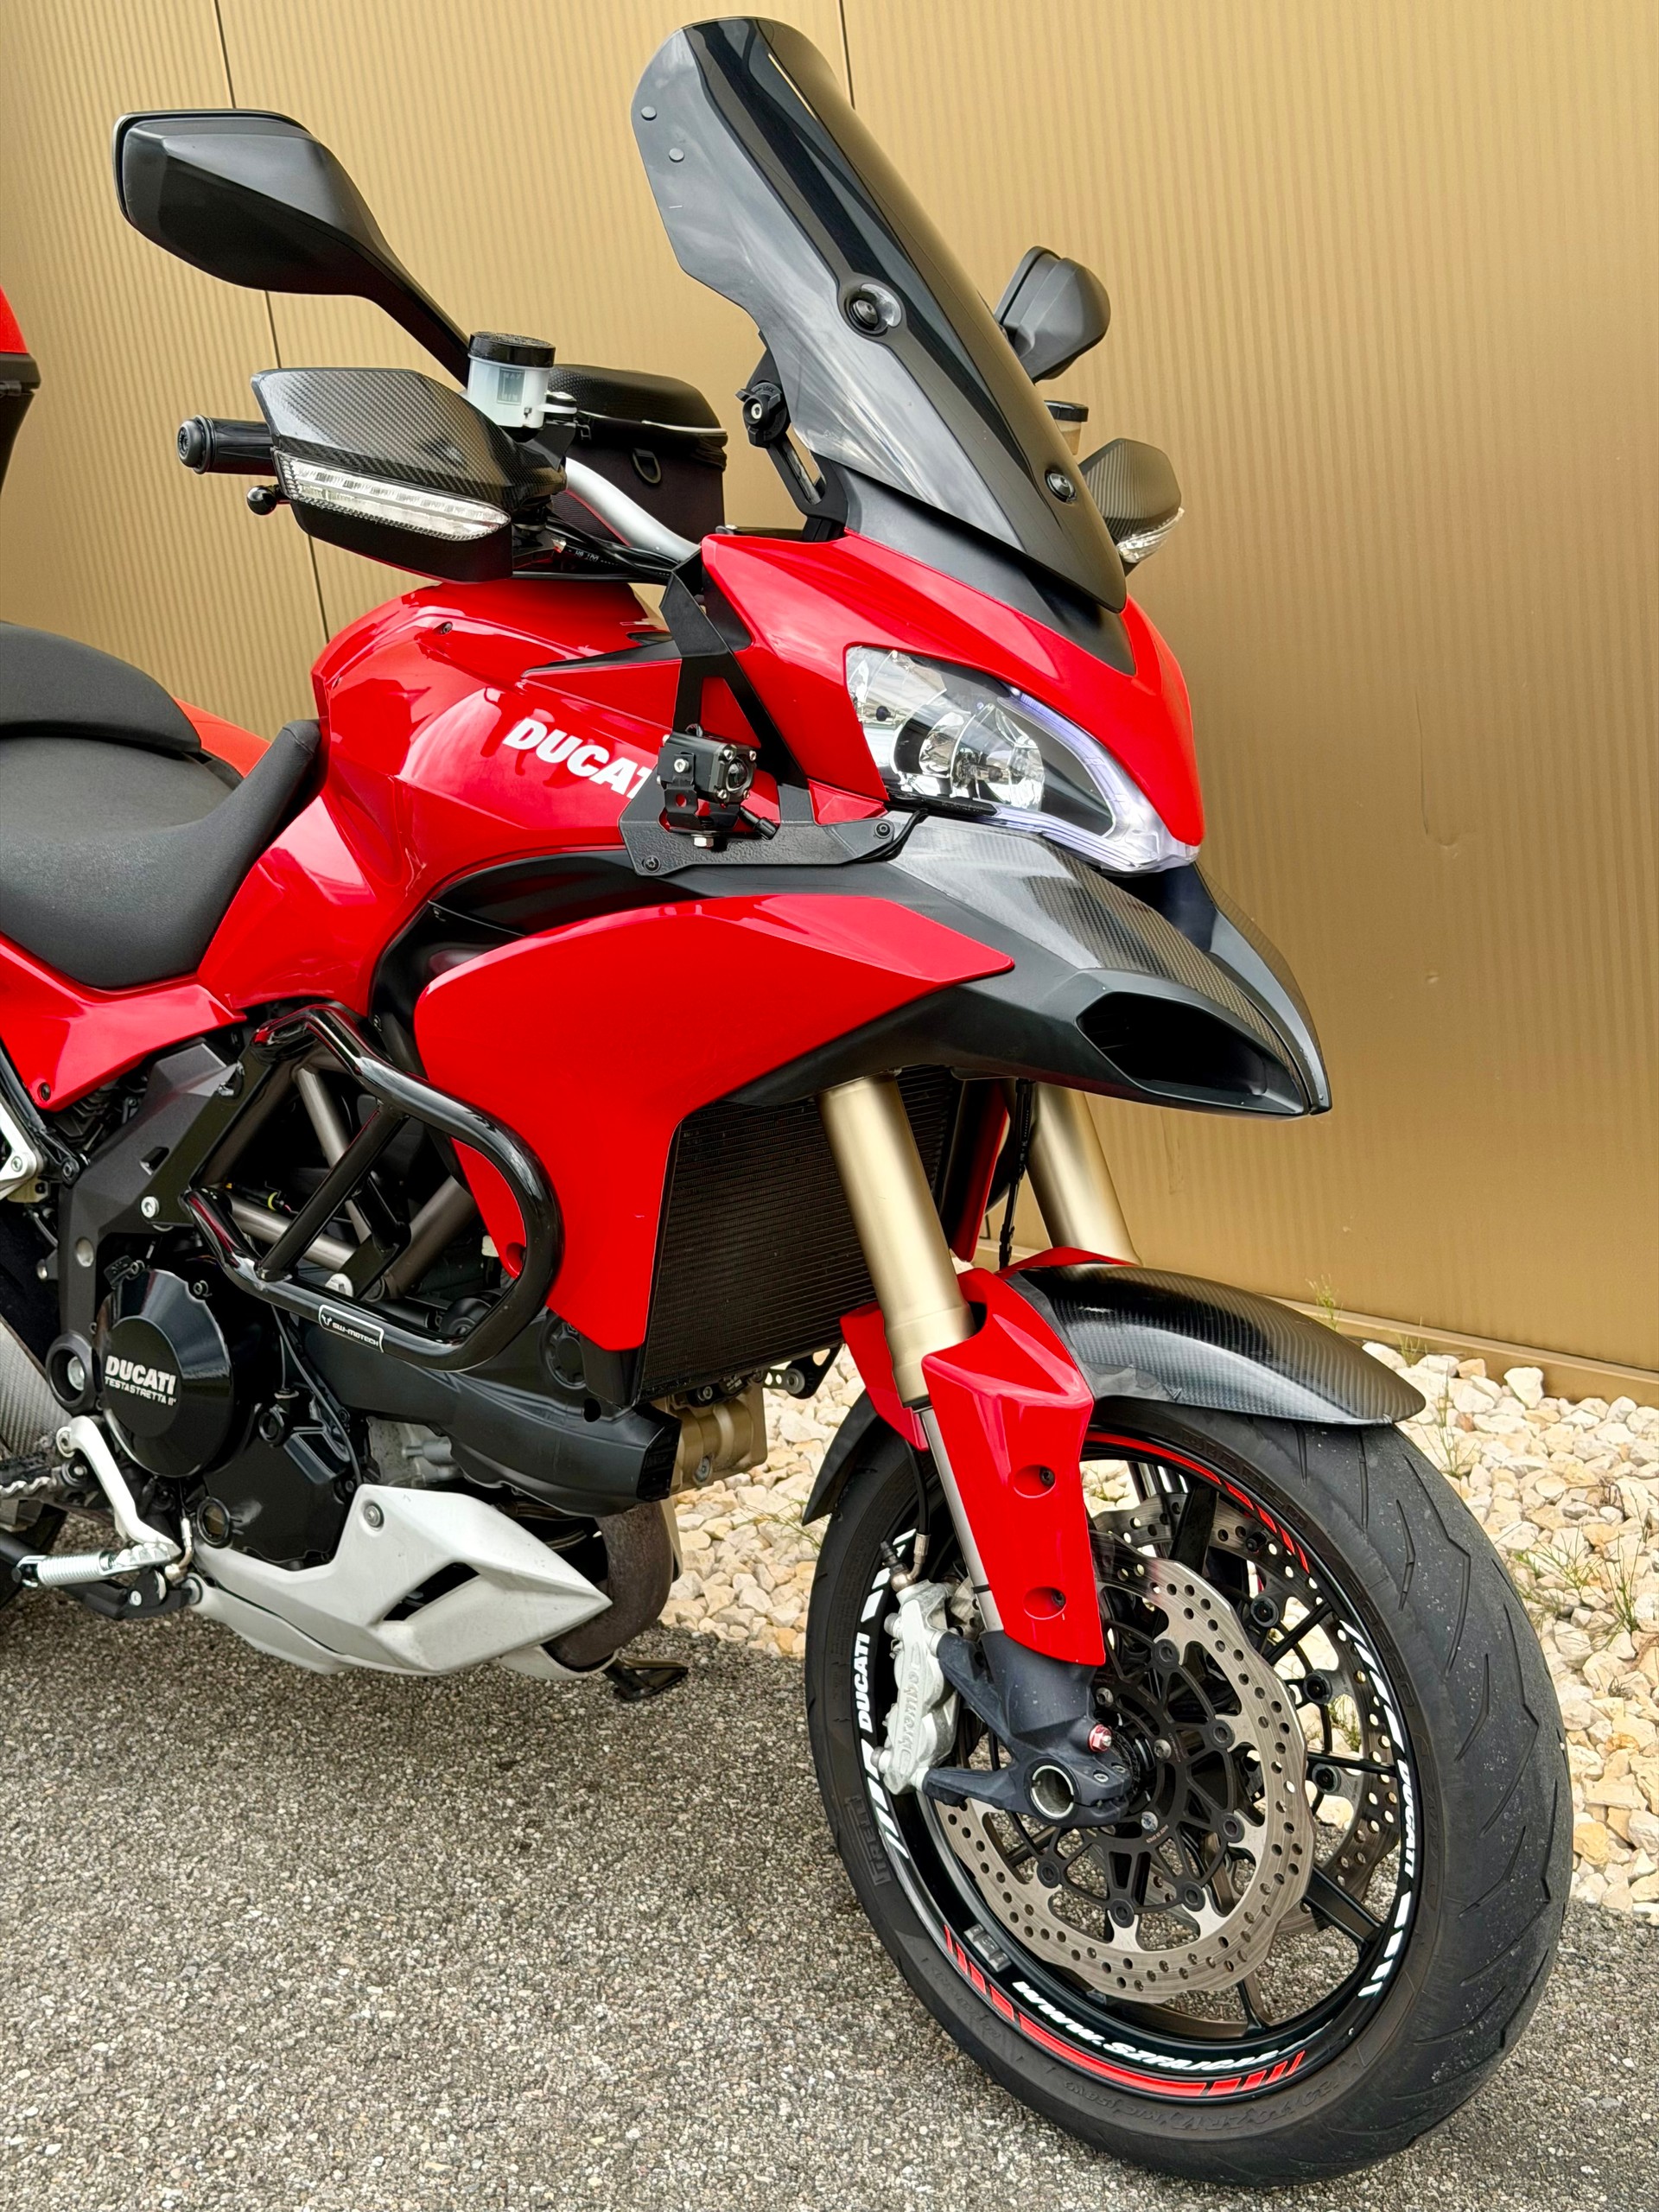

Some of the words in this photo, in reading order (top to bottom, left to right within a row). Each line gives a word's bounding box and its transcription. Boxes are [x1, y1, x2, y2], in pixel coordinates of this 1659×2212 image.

[105, 1355, 176, 1395] DUCATI
[105, 1376, 167, 1404] TESTASTRETTA
[854, 1632, 874, 1733] DUCATI
[897, 1669, 925, 1751] brembo
[844, 1796, 893, 1885] PIRELLI
[1396, 1758, 1416, 1879] DUCATI
